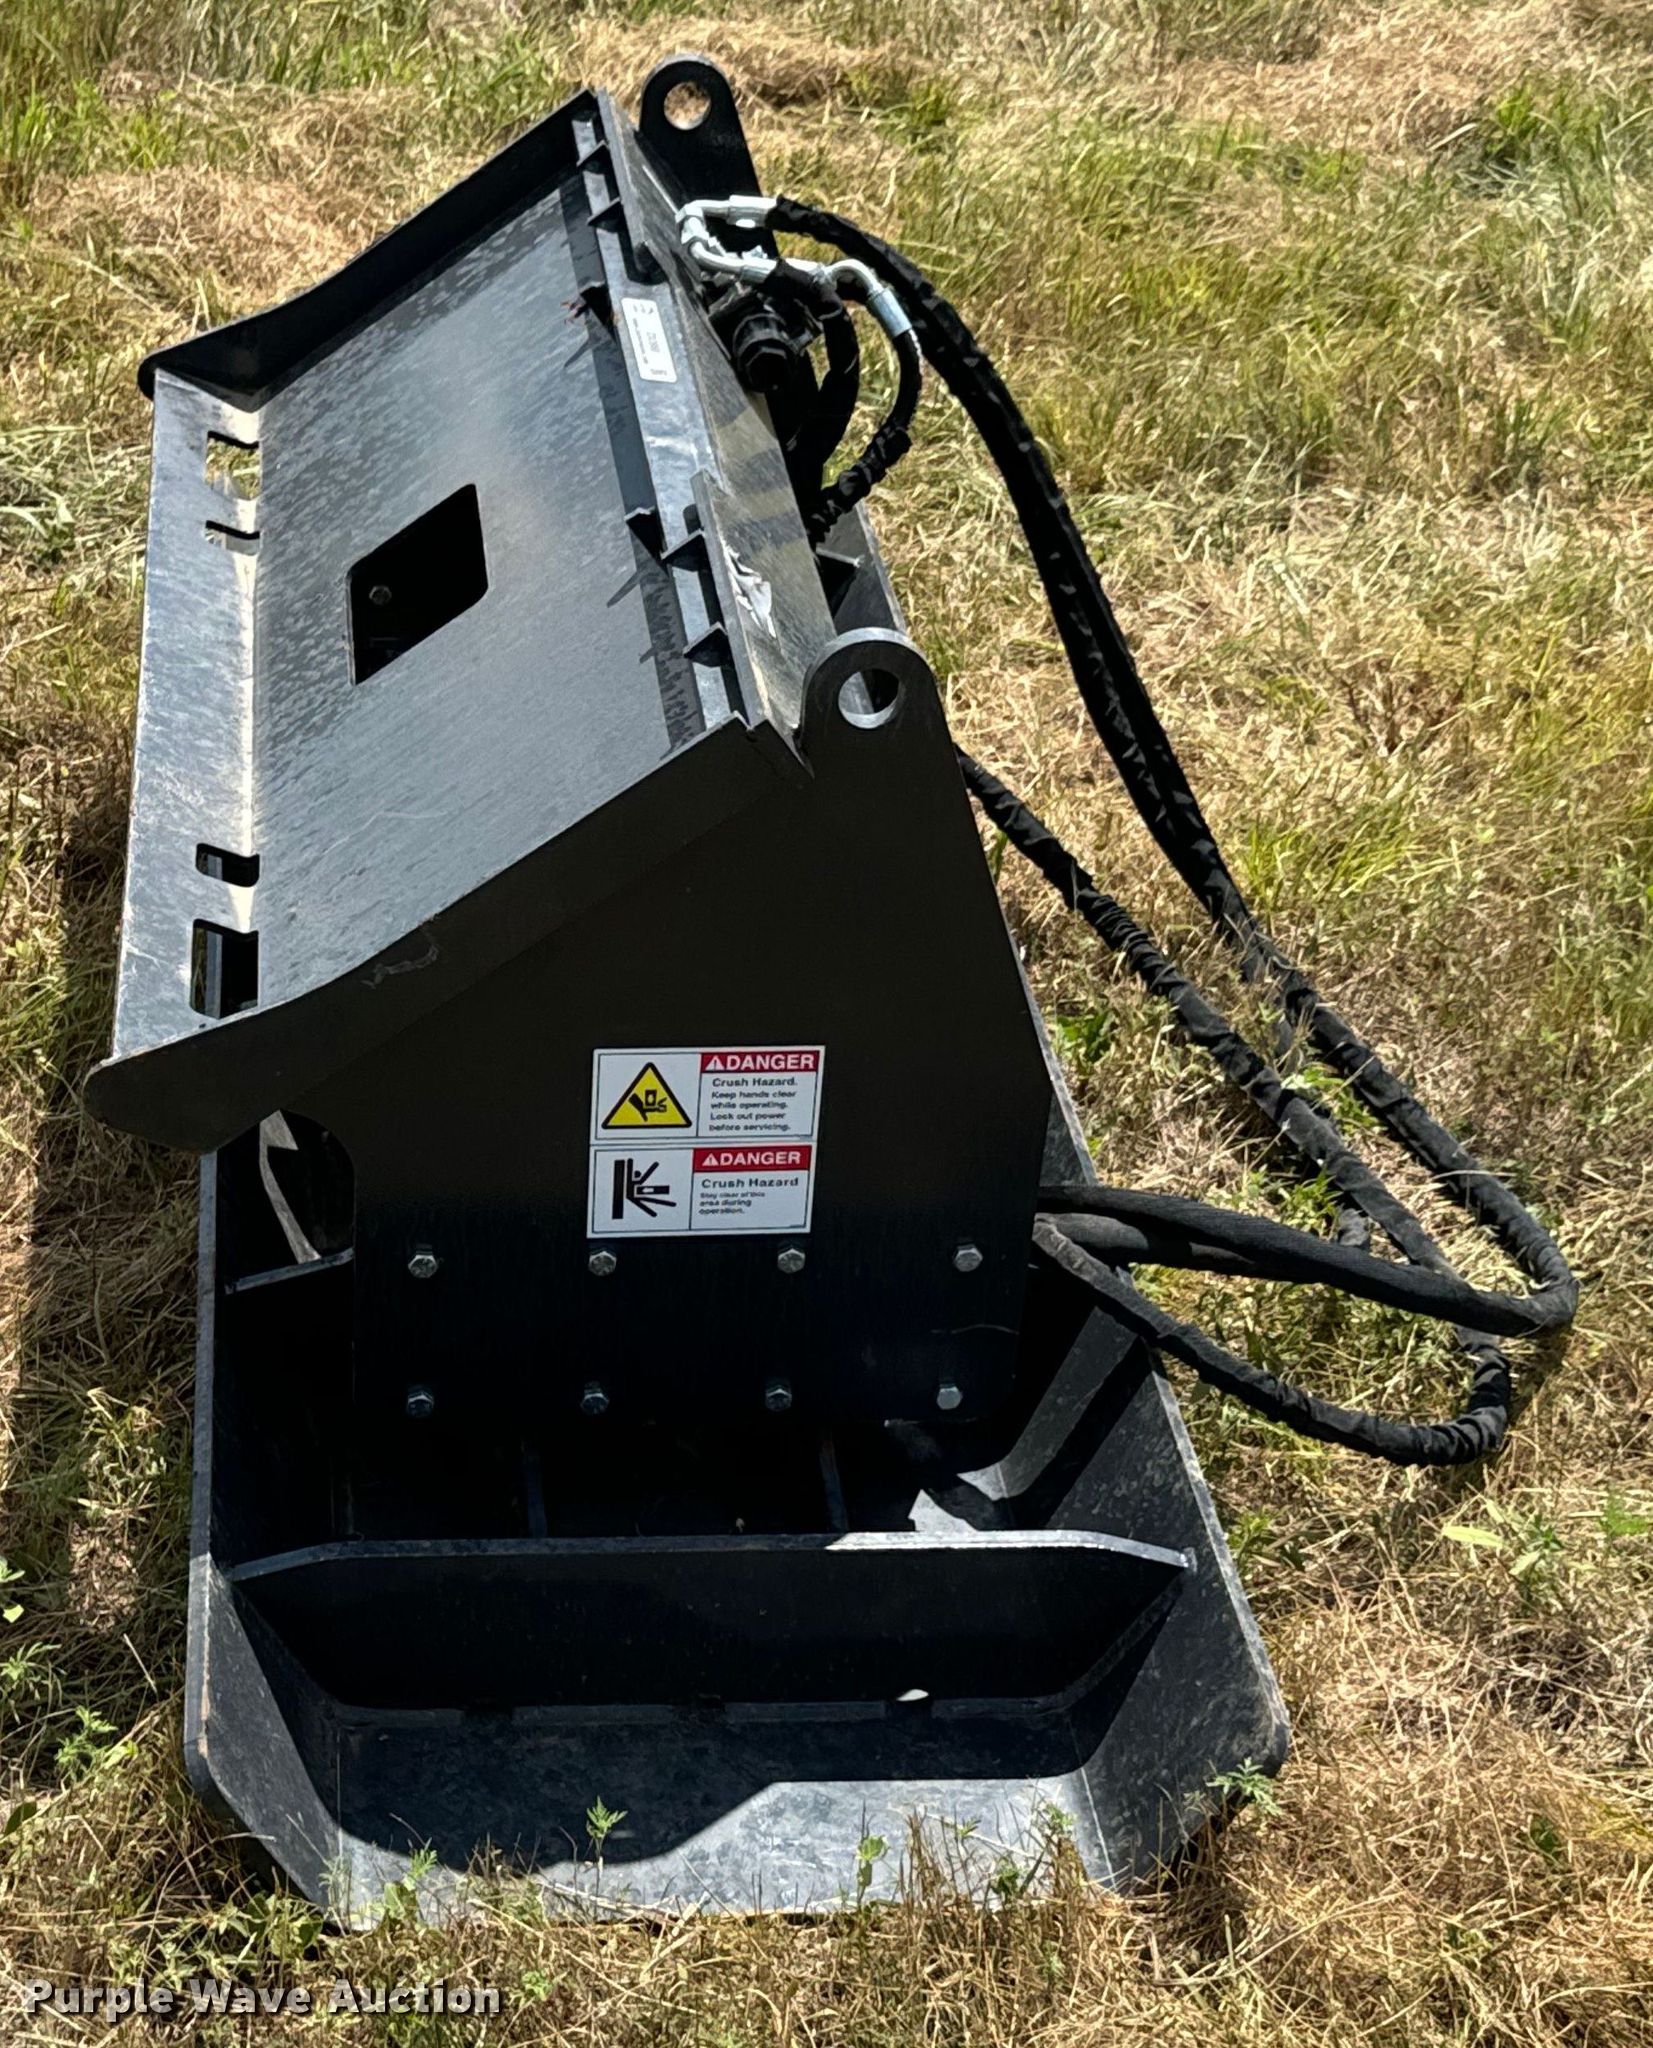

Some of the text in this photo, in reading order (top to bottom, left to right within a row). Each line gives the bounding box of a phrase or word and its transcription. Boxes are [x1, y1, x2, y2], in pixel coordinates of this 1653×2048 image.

[726, 1054, 815, 1070] DANGER
[712, 1077, 798, 1087] Crush Hazard.
[711, 1091, 736, 1100] Keep
[772, 1090, 797, 1098] clear
[739, 1101, 788, 1110] operating.
[743, 1123, 791, 1132] servicing.
[719, 1151, 802, 1166] DANGER
[701, 1177, 799, 1188] Crush Hazard
[721, 1199, 752, 1207] during
